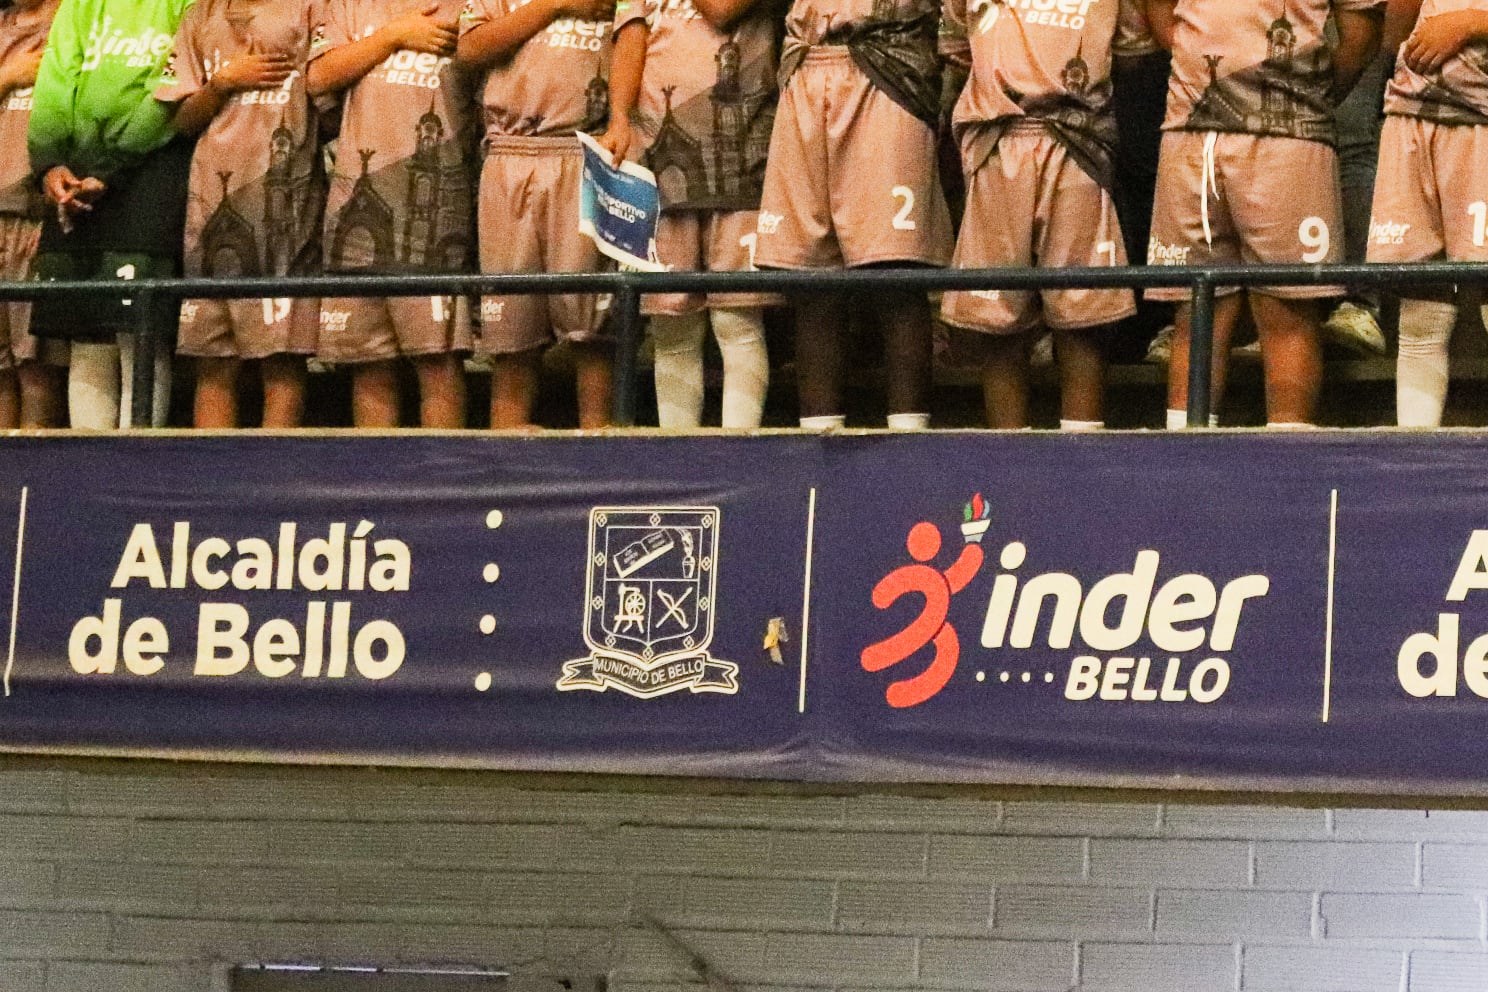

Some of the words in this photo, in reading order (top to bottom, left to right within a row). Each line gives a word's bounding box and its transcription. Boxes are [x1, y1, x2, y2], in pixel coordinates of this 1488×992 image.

[1025, 11, 1085, 30] BELLO
[103, 26, 175, 56] inde
[549, 34, 602, 52] BELLO
[386, 70, 441, 89] BELLO
[241, 91, 290, 105] BELLO
[892, 185, 916, 230] 2
[1299, 216, 1330, 263] 9
[320, 309, 350, 324] nder
[110, 520, 411, 592] Alcaldía
[981, 542, 1270, 651] inder
[68, 600, 170, 676] de
[194, 601, 406, 680] Bello
[594, 658, 649, 683] MUNICIPIO
[651, 671, 666, 685] DE
[668, 661, 703, 680] BELLO
[1065, 655, 1231, 703] BELLO
